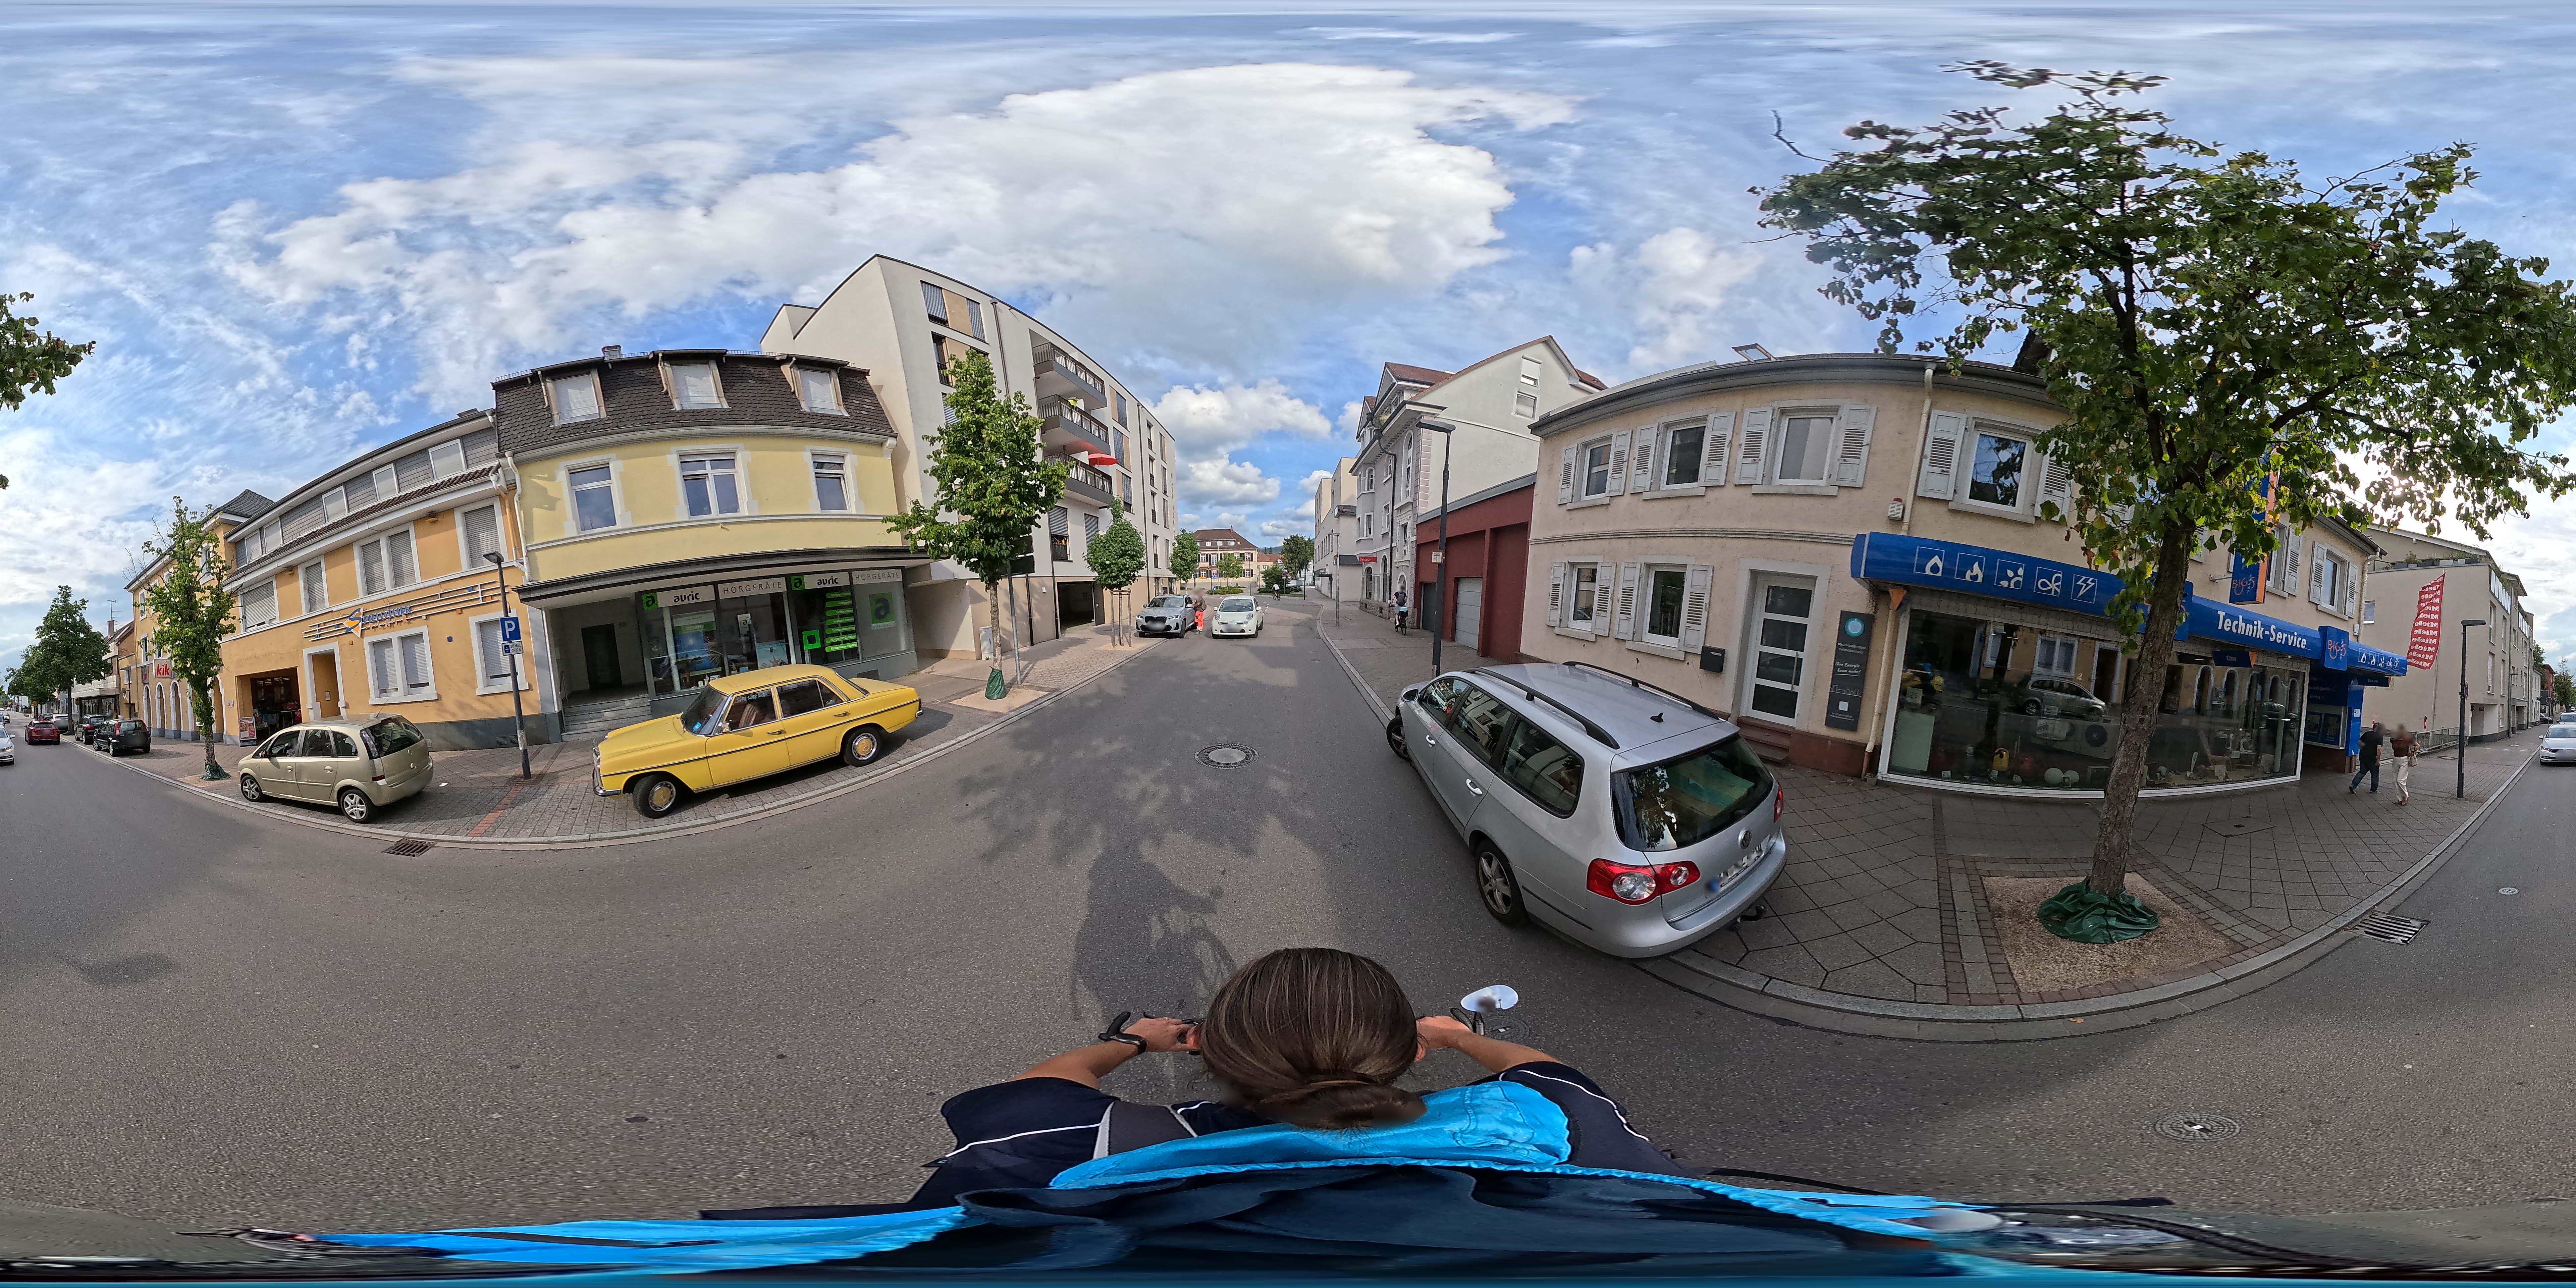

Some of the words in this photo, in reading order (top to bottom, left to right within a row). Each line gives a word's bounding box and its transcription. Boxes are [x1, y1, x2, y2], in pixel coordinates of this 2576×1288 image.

[723, 581, 782, 594] HÖRGERÄTE
[794, 578, 803, 588] a
[817, 576, 839, 586] auric
[646, 595, 655, 607] a
[674, 591, 700, 603] auric
[504, 620, 515, 638] P
[2218, 611, 2306, 649] Technik-Service
[157, 664, 170, 676] kik
